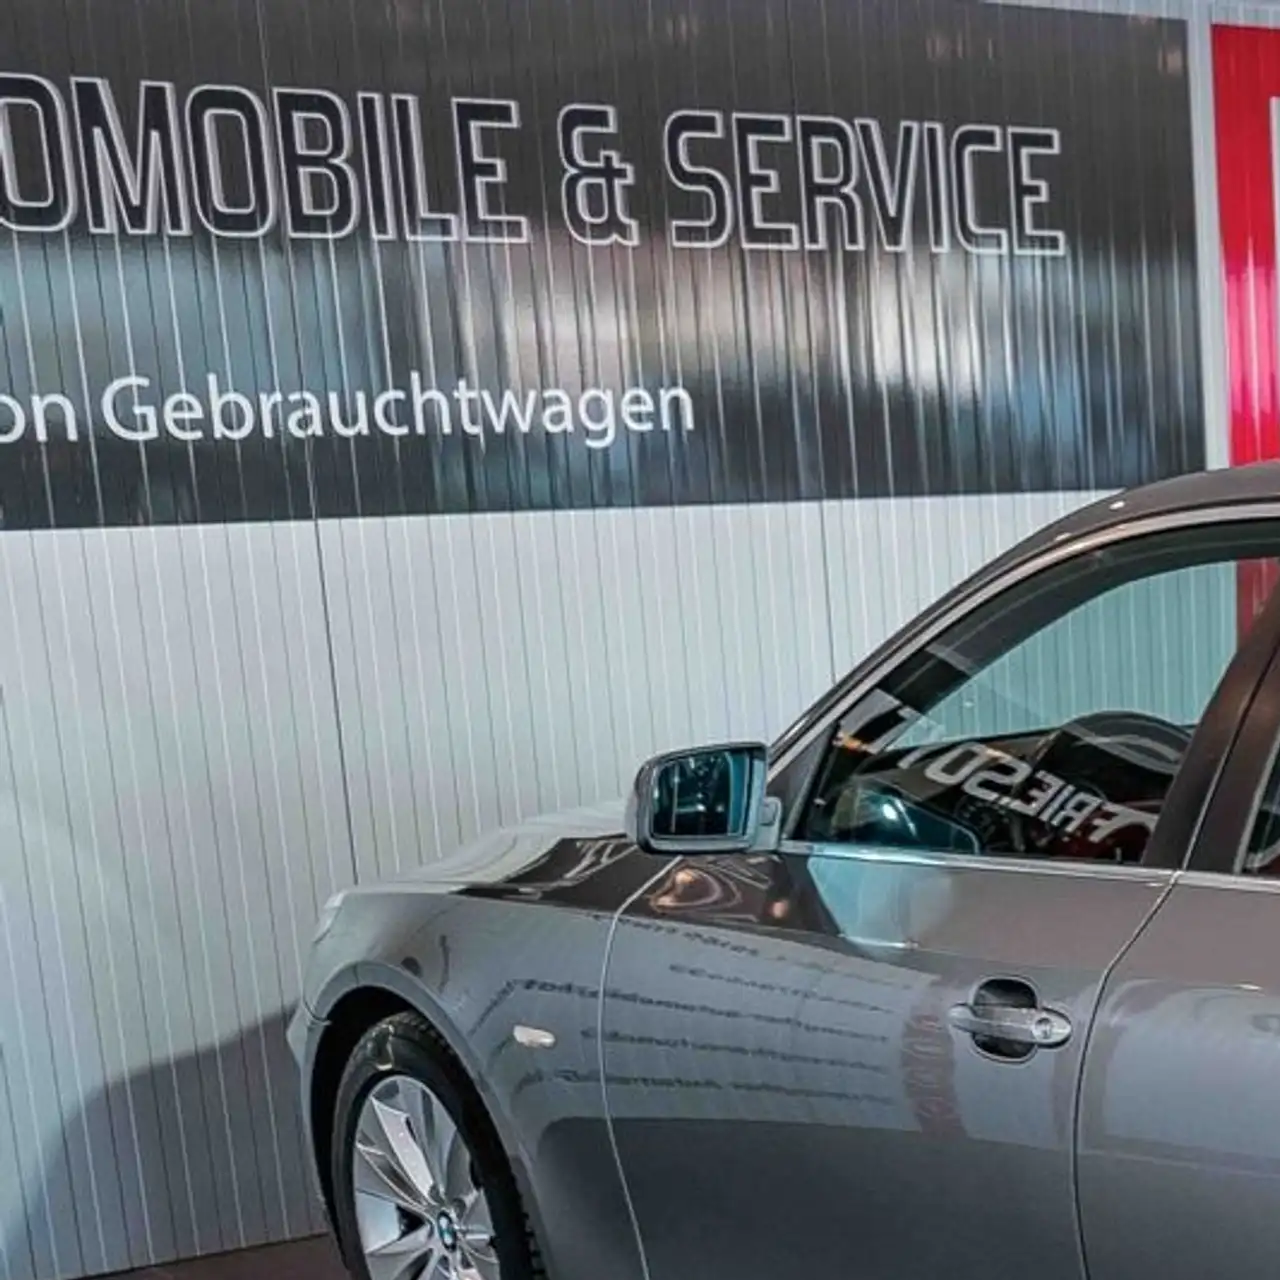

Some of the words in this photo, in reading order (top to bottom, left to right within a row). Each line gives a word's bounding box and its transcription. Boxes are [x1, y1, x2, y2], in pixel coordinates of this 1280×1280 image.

[557, 103, 640, 247] &
[664, 109, 1066, 257] SERVICE
[103, 370, 695, 449] Gebrauchtwagen
